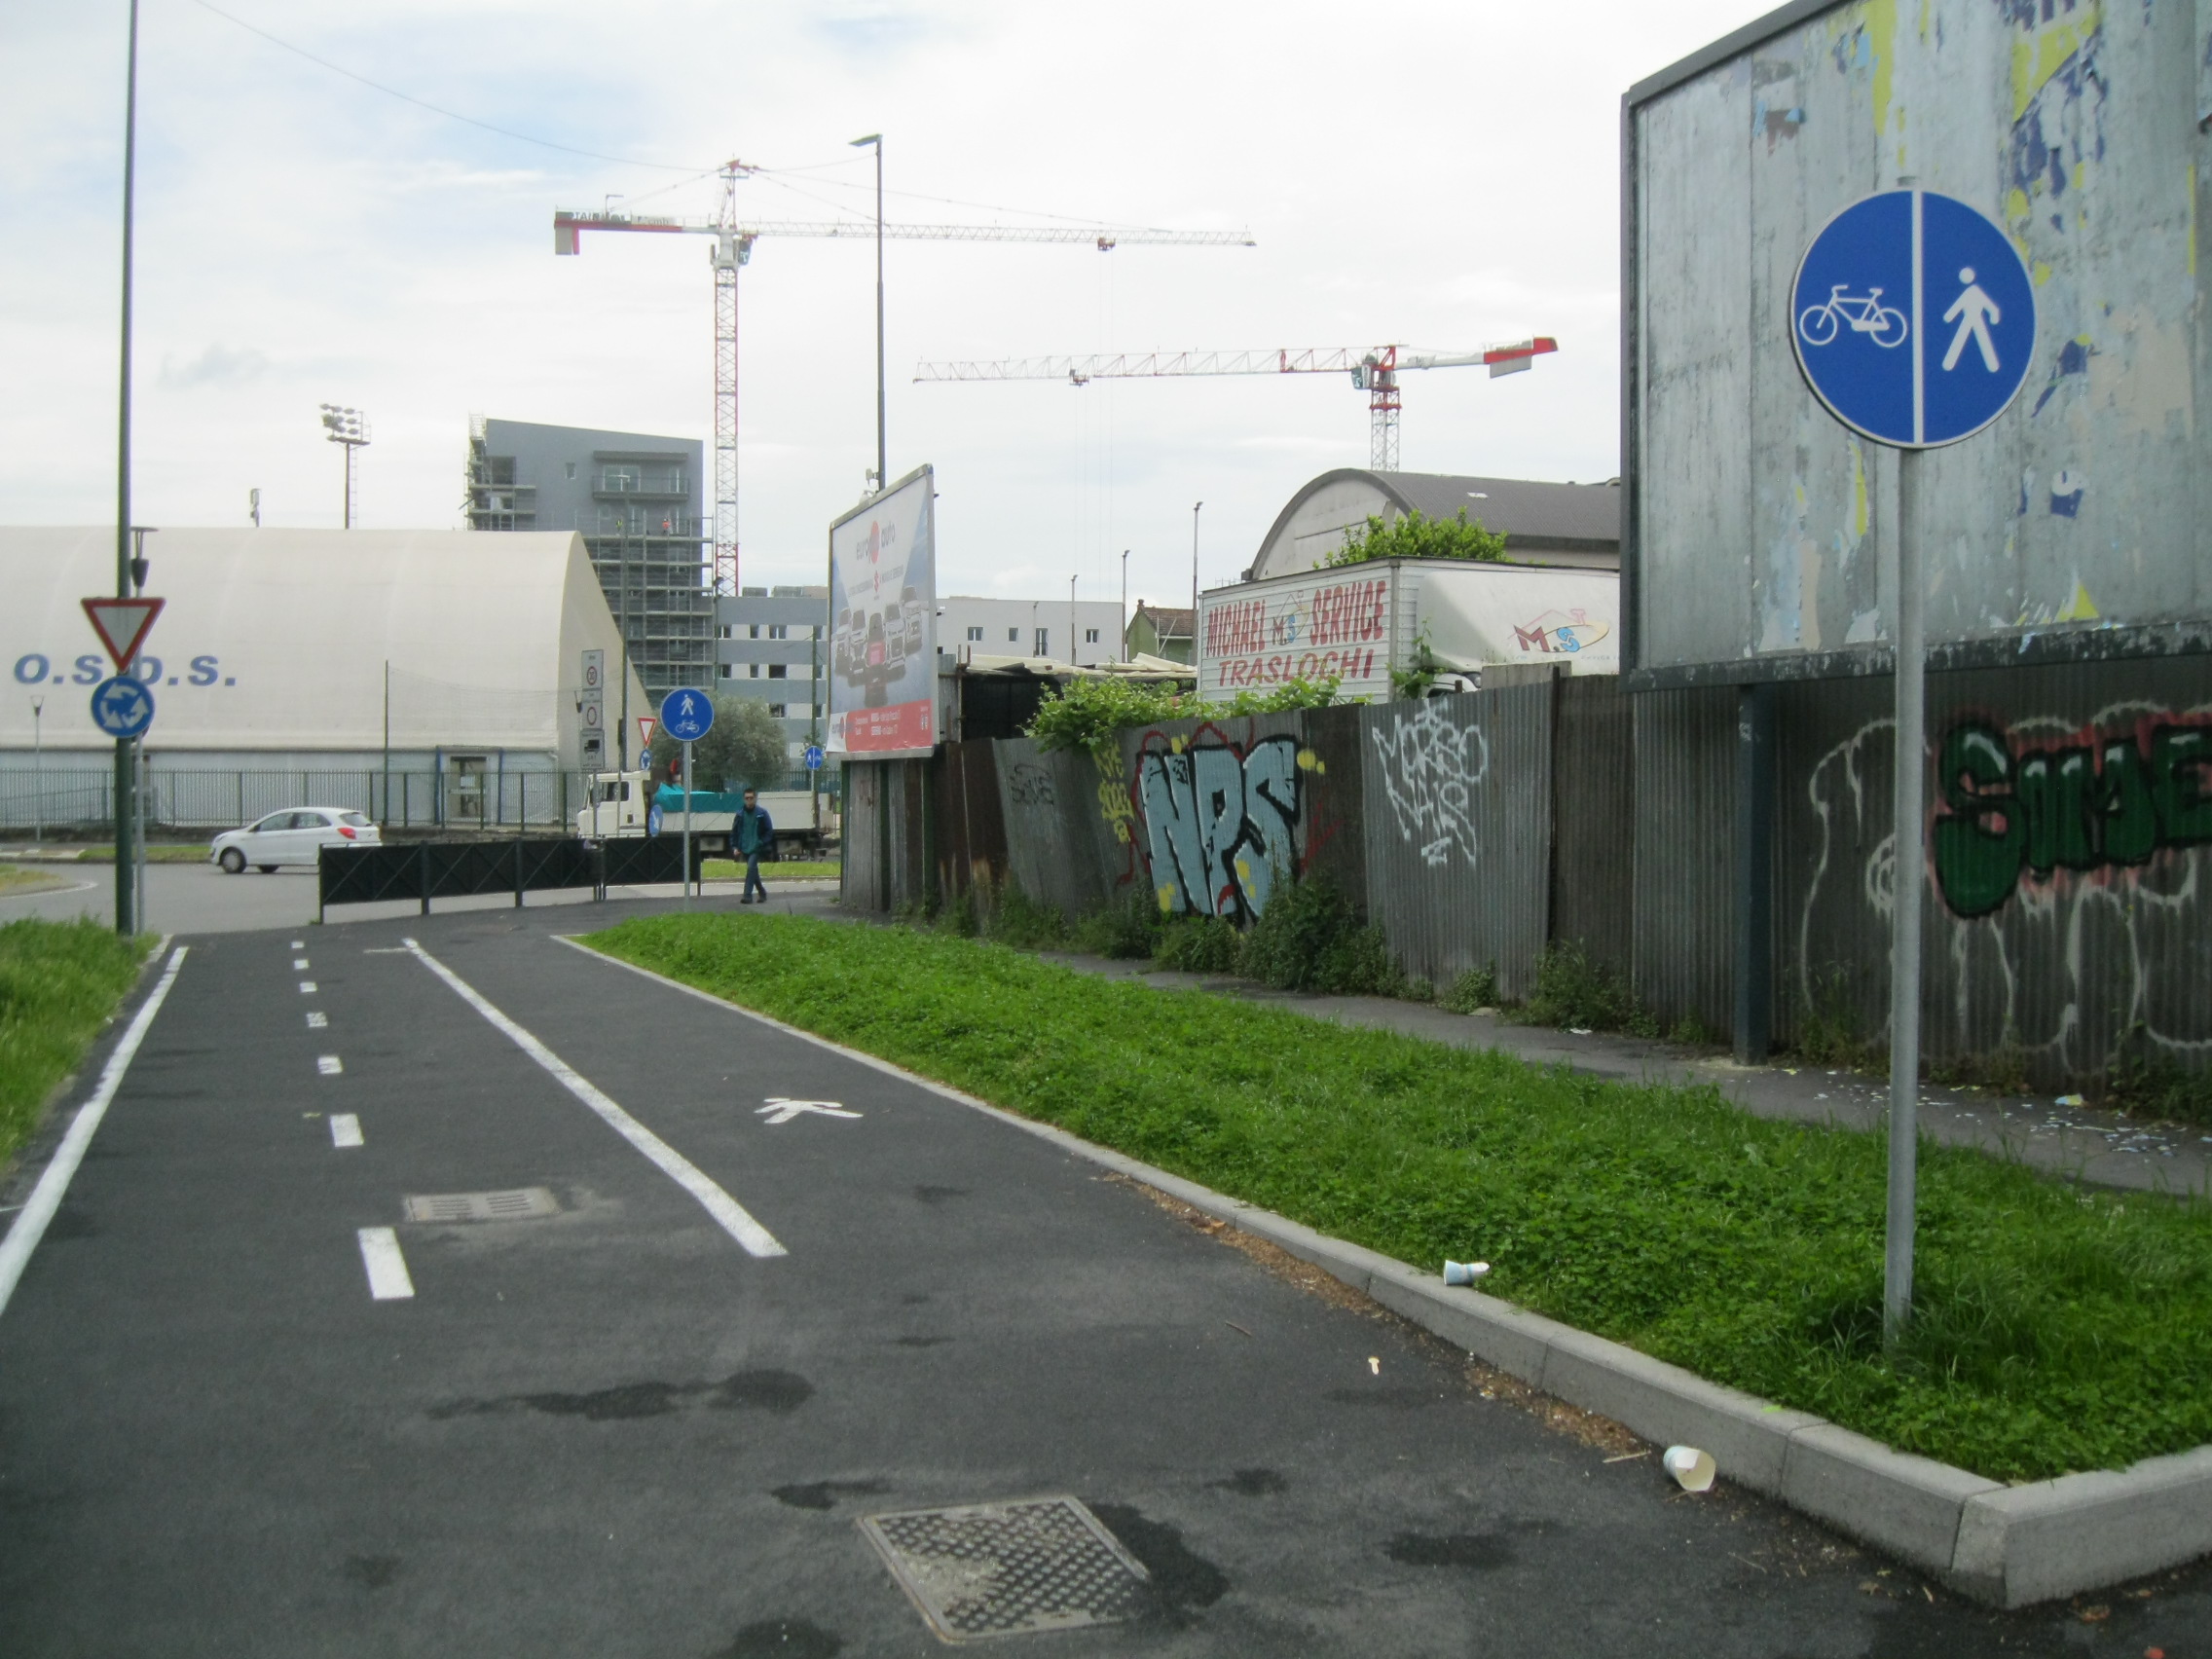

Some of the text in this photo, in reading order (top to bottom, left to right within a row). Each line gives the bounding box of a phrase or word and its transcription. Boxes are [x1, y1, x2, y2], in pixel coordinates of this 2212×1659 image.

[1206, 580, 1385, 658] MICHAEL SERVICE
[1219, 646, 1374, 686] TRASLOCHI
